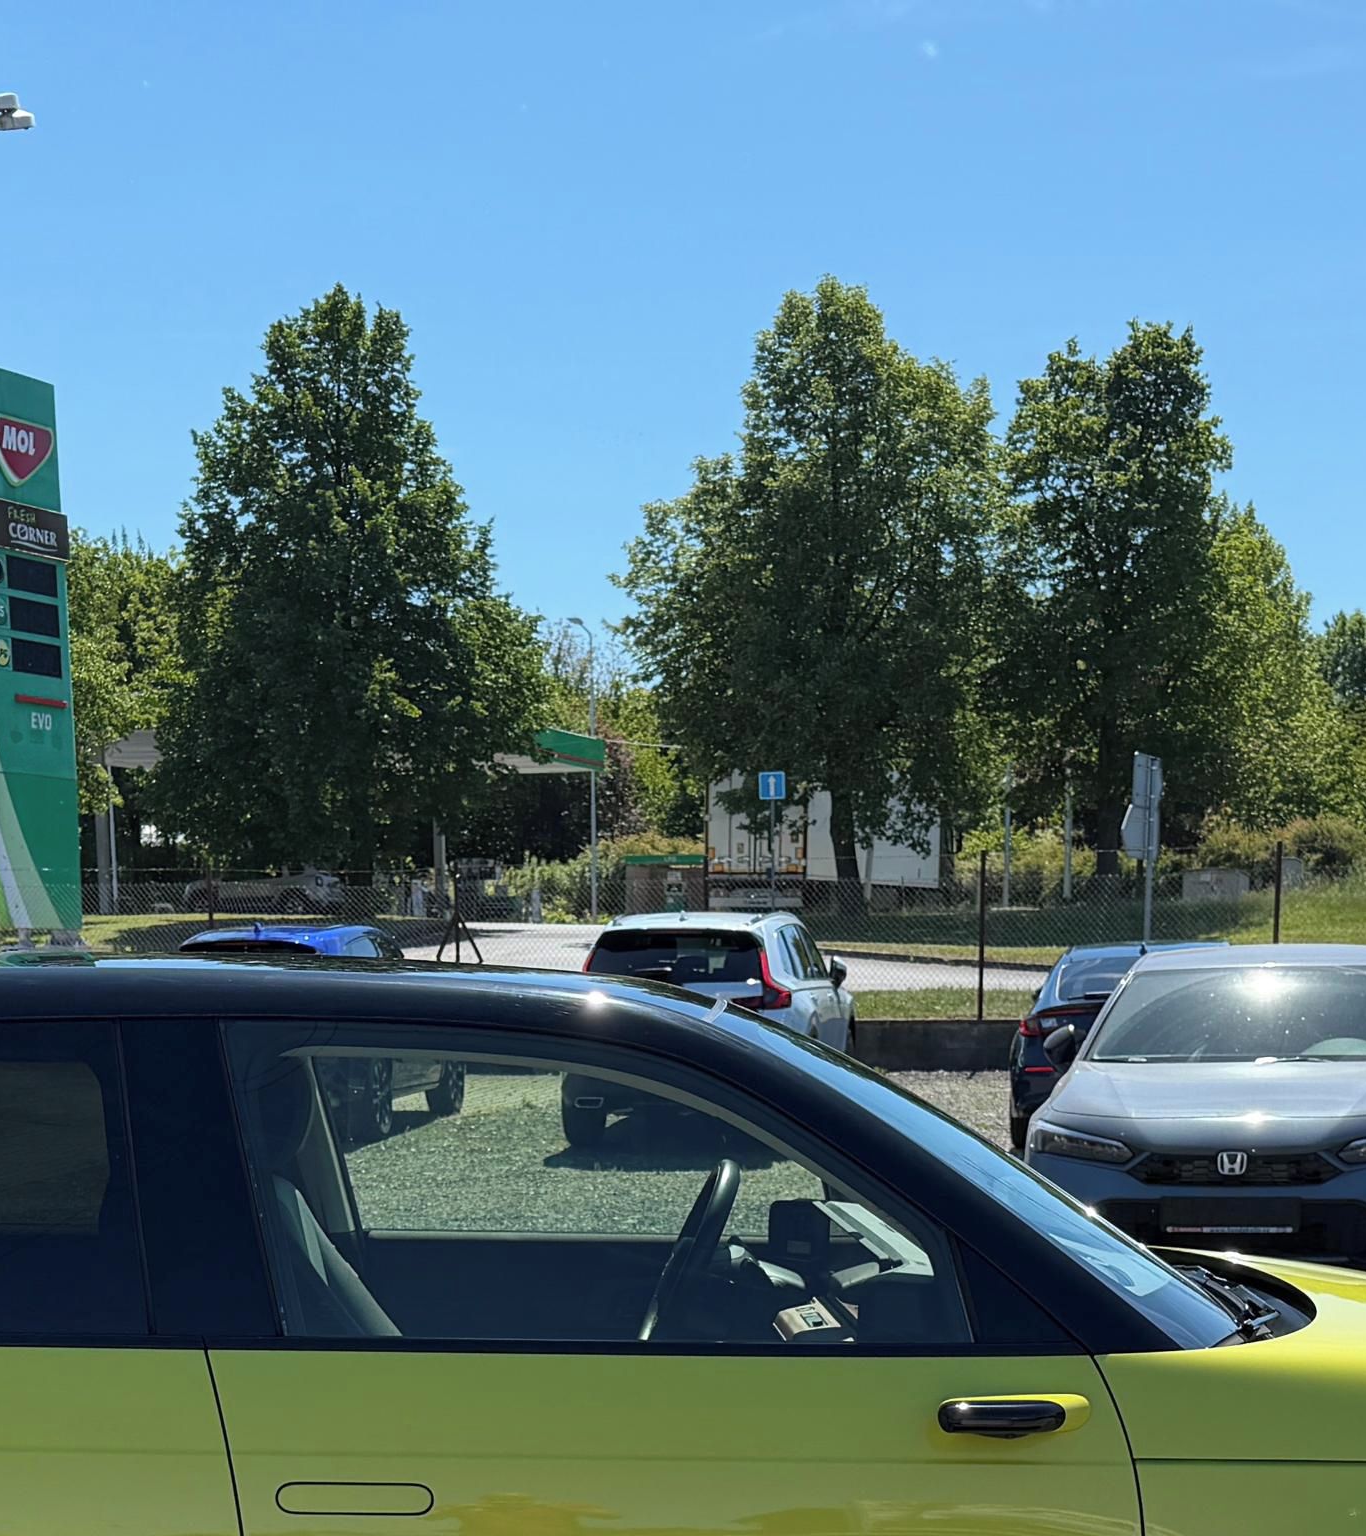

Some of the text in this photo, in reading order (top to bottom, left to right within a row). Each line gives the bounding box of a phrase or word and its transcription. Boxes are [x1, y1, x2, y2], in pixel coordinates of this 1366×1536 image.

[2, 425, 35, 456] MOL
[9, 523, 58, 547] CORNER
[31, 712, 52, 731] EVO
